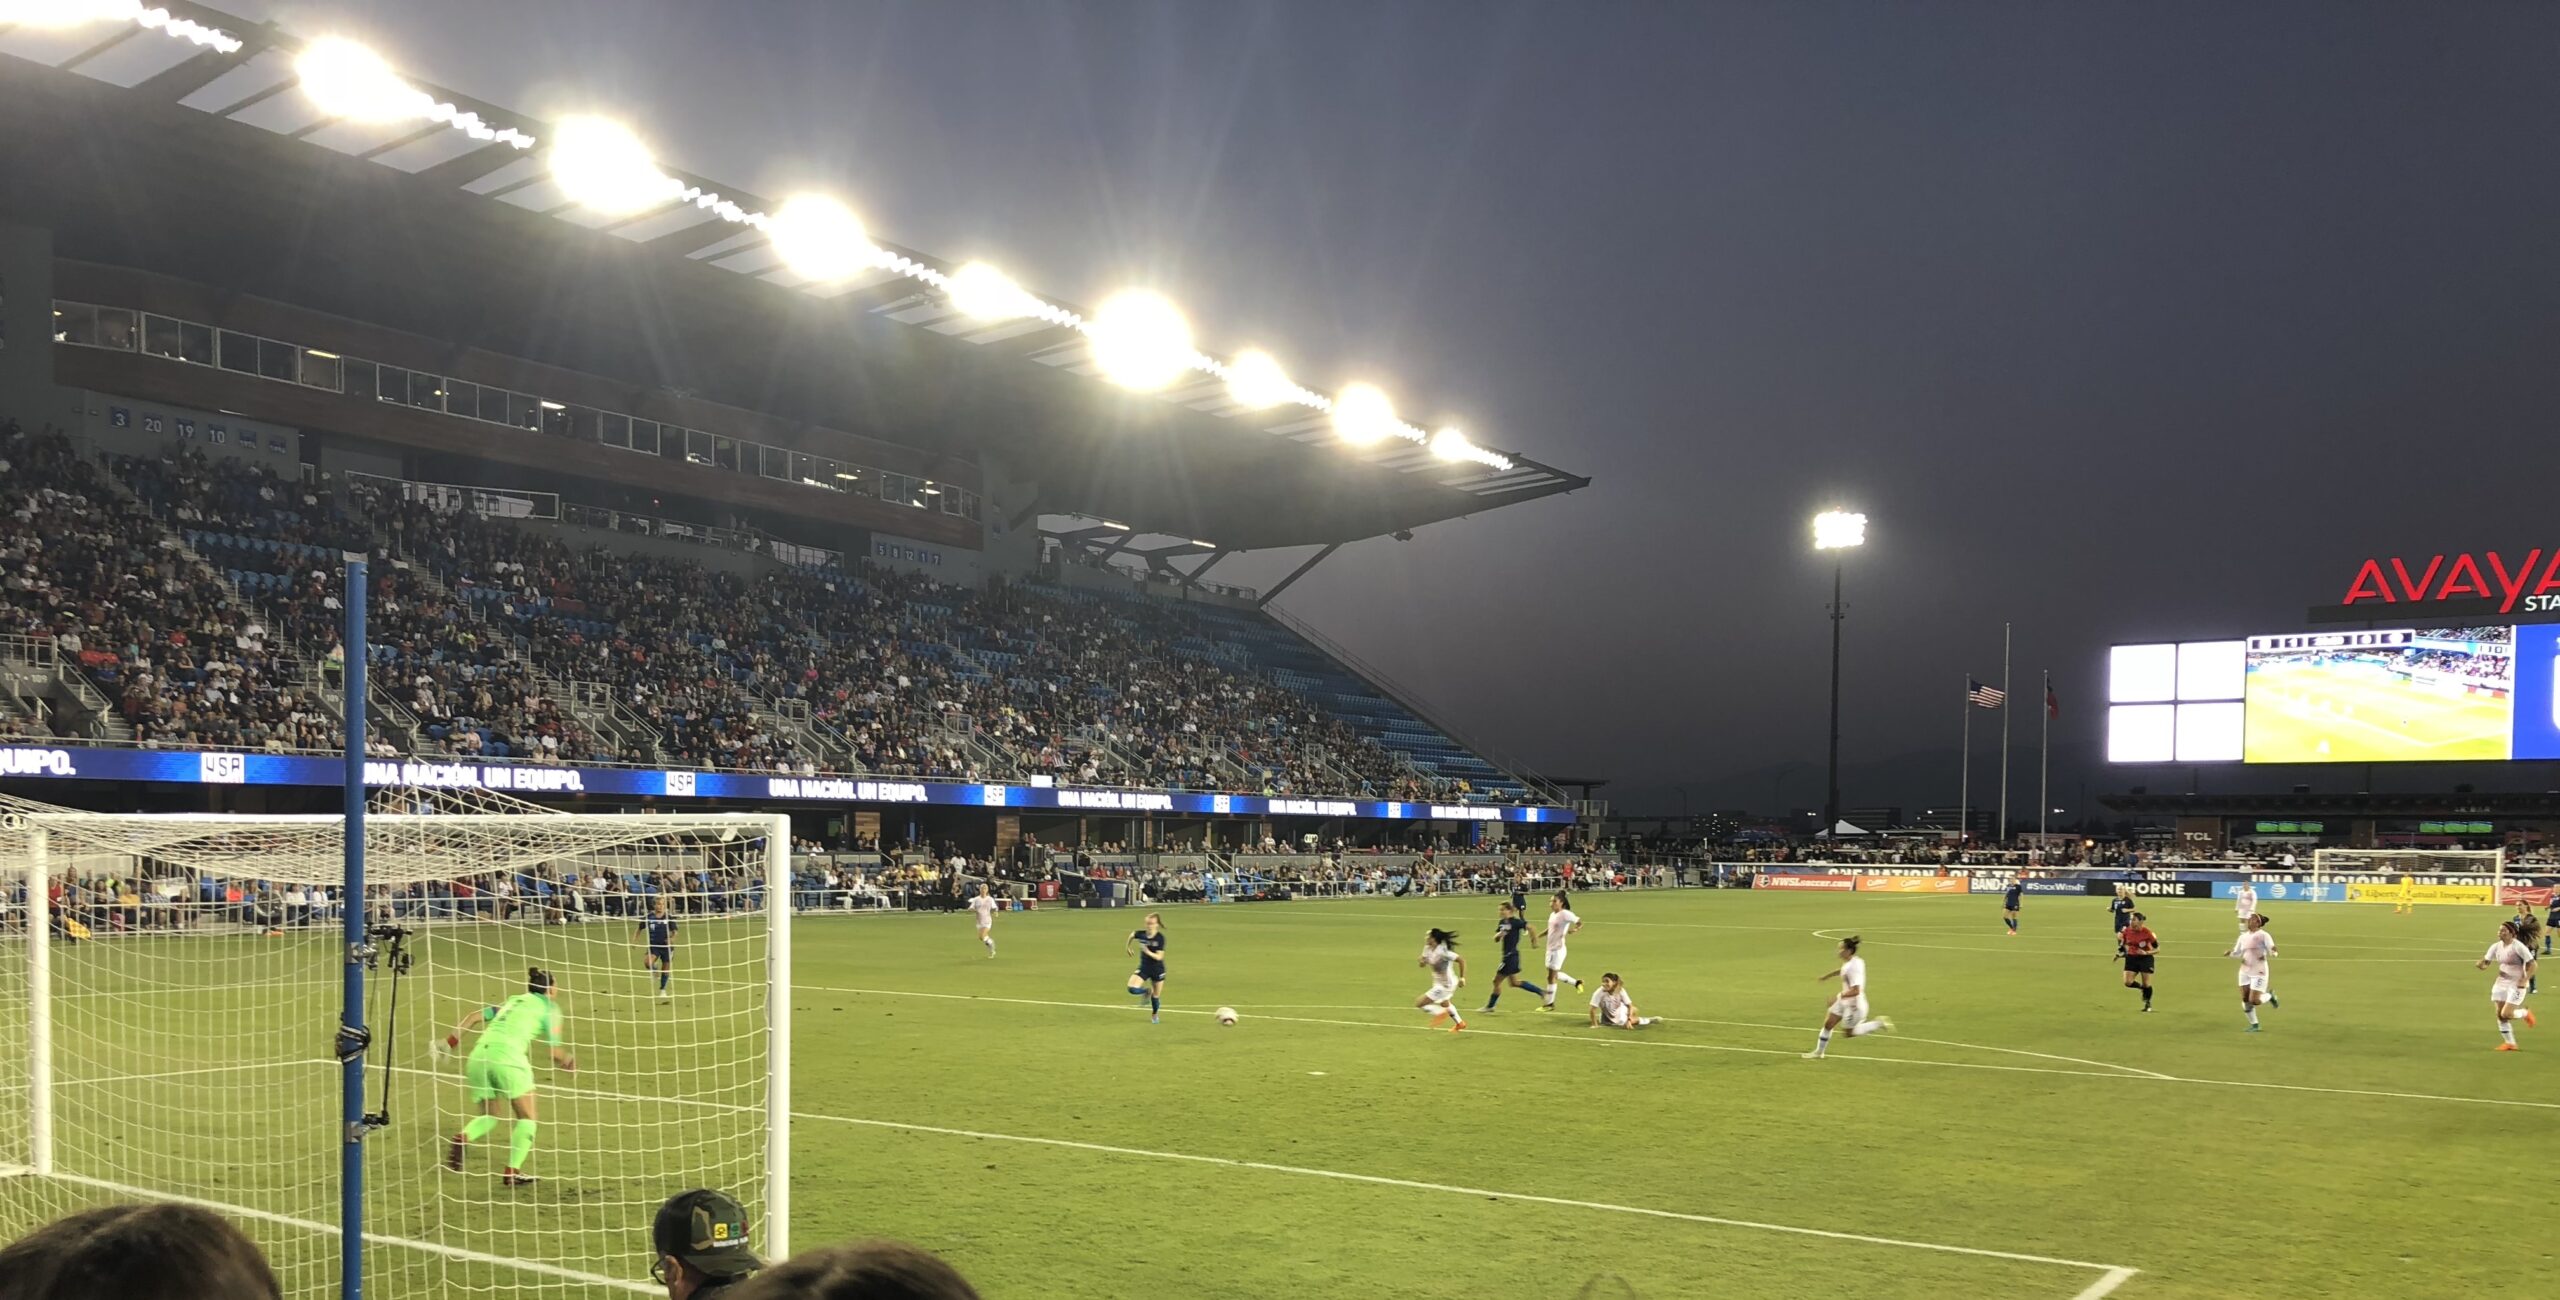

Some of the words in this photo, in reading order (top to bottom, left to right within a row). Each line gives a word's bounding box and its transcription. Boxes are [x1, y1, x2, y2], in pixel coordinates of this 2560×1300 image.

[115, 412, 126, 426] 3
[144, 418, 162, 433] 20
[177, 424, 194, 438] 19
[210, 429, 225, 443] 10
[205, 756, 240, 776] USA
[484, 767, 512, 788] UN
[768, 778, 800, 797] UNA
[857, 781, 877, 799] UN
[2183, 832, 2212, 841] TCL
[2112, 882, 2186, 896] THORNE
